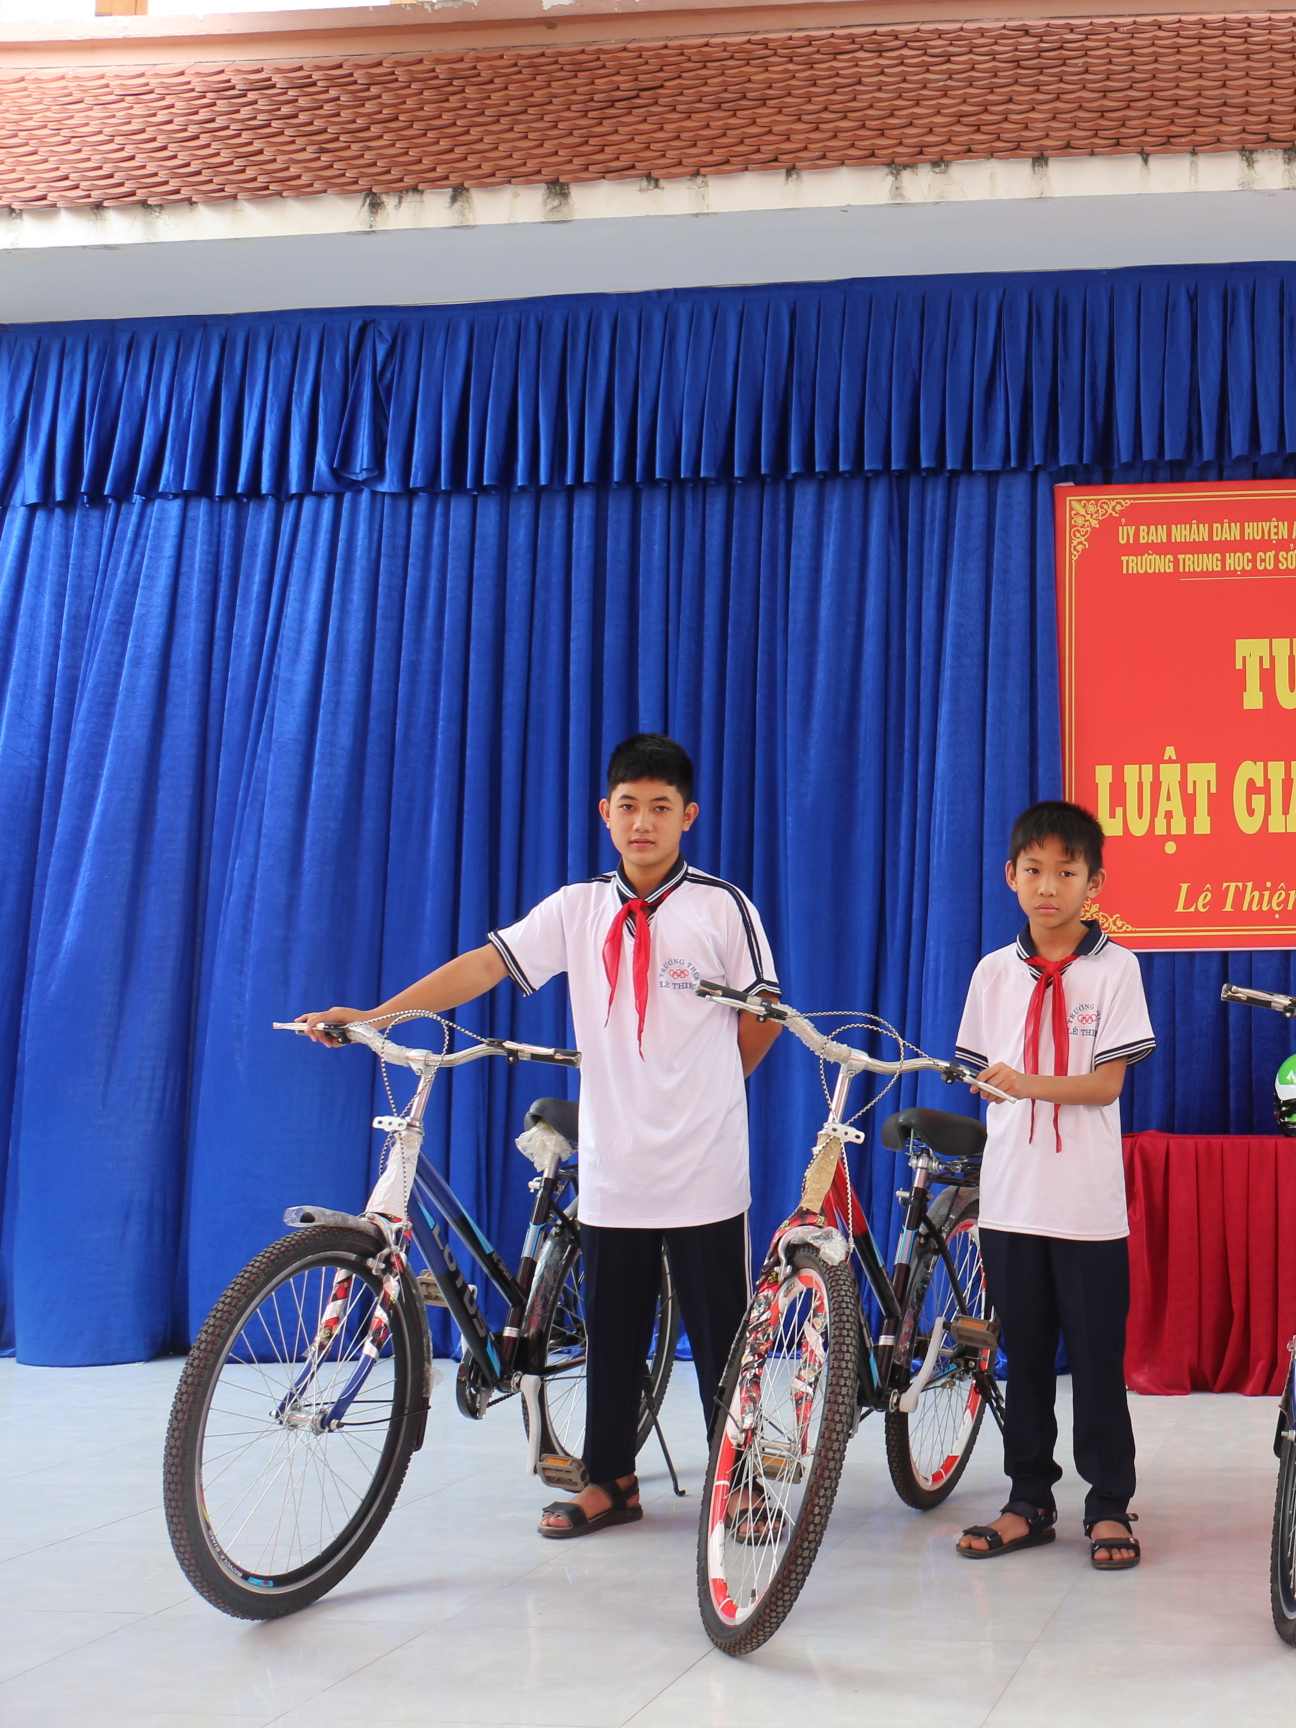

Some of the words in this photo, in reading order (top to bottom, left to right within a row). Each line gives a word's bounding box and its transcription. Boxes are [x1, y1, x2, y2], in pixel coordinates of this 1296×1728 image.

[1118, 518, 1136, 545] ỦY
[1139, 524, 1167, 544] BAN
[1171, 519, 1209, 543] NHÂN
[1212, 519, 1241, 542] DÂN
[1244, 517, 1289, 544] HUYỆN
[1120, 550, 1174, 574] TRƯỜNG
[1177, 552, 1222, 573] TRUNG
[1225, 551, 1253, 575] HỌC
[1256, 550, 1276, 571] CƠ
[1094, 745, 1217, 855] LUẬT
[1175, 882, 1212, 913] Lê
[430, 1222, 488, 1339] LOTUS
